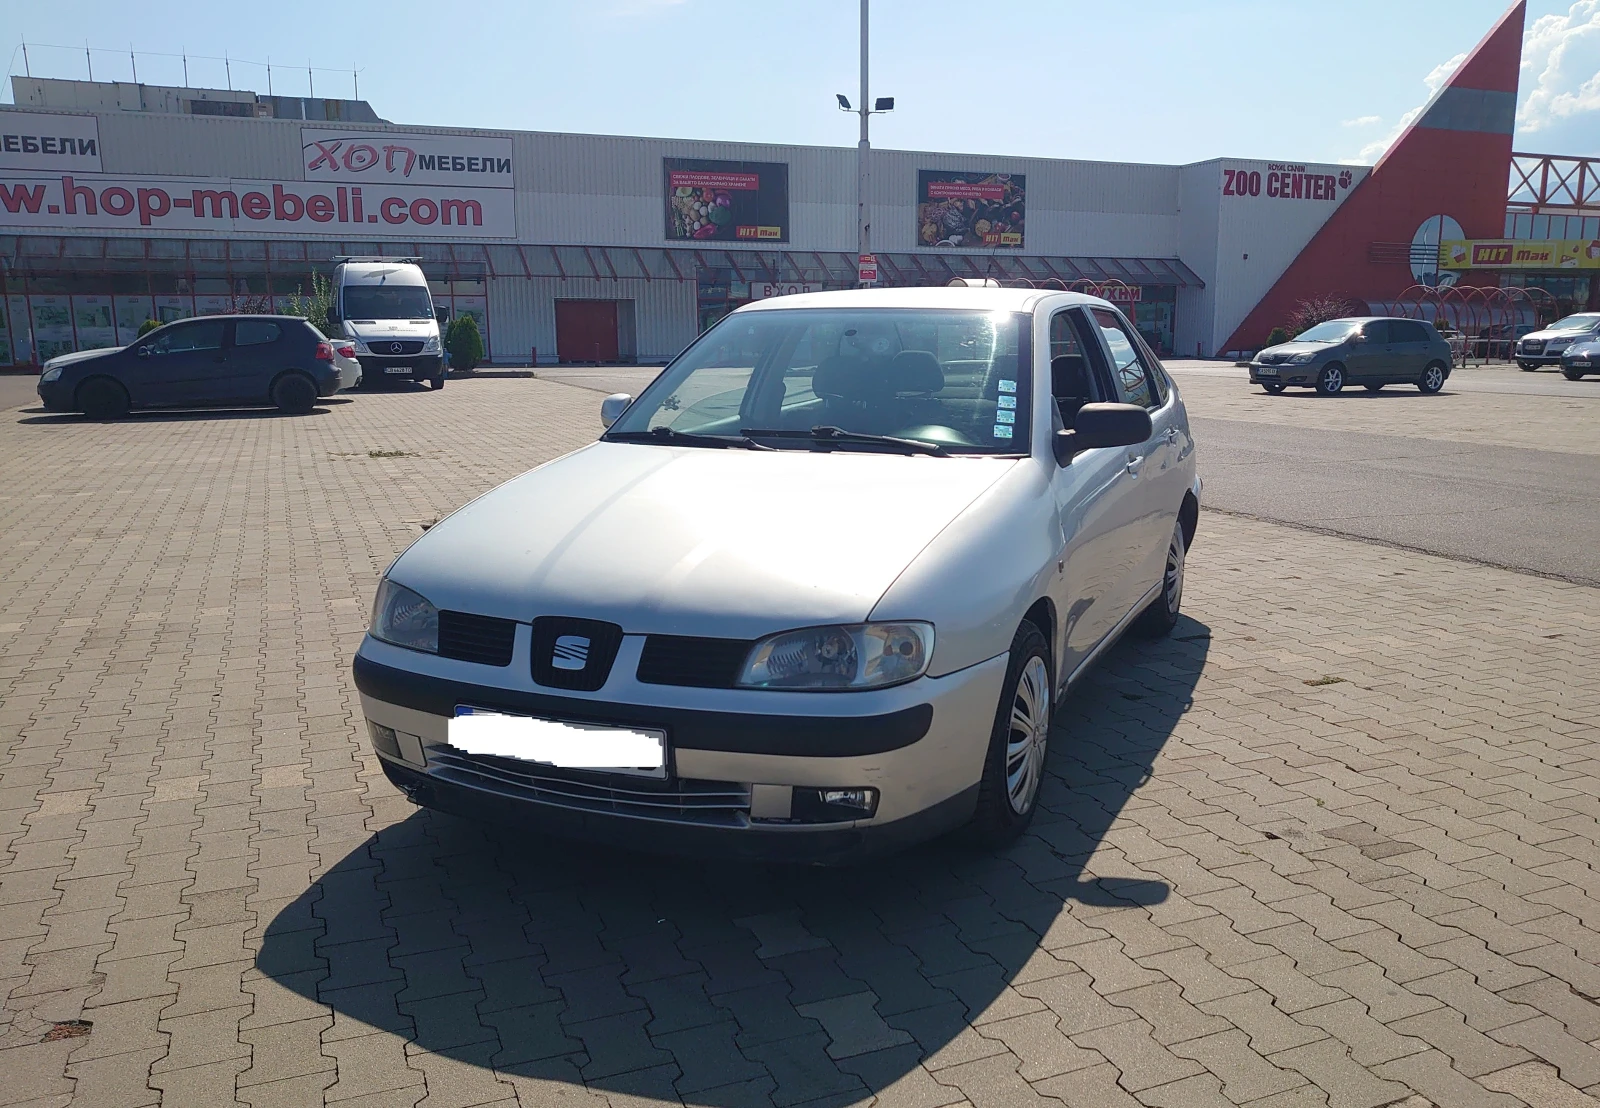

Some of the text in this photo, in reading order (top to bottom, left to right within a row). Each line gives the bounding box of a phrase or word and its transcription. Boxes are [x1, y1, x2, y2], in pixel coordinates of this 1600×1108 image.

[0, 134, 97, 156] ЕБЕЛИ
[418, 154, 512, 174] МЕБЕЛИ
[1268, 163, 1286, 172] ROYAL
[1223, 169, 1336, 200] ZOO CENTER
[739, 228, 756, 237] HIT
[1477, 248, 1508, 262] HIT
